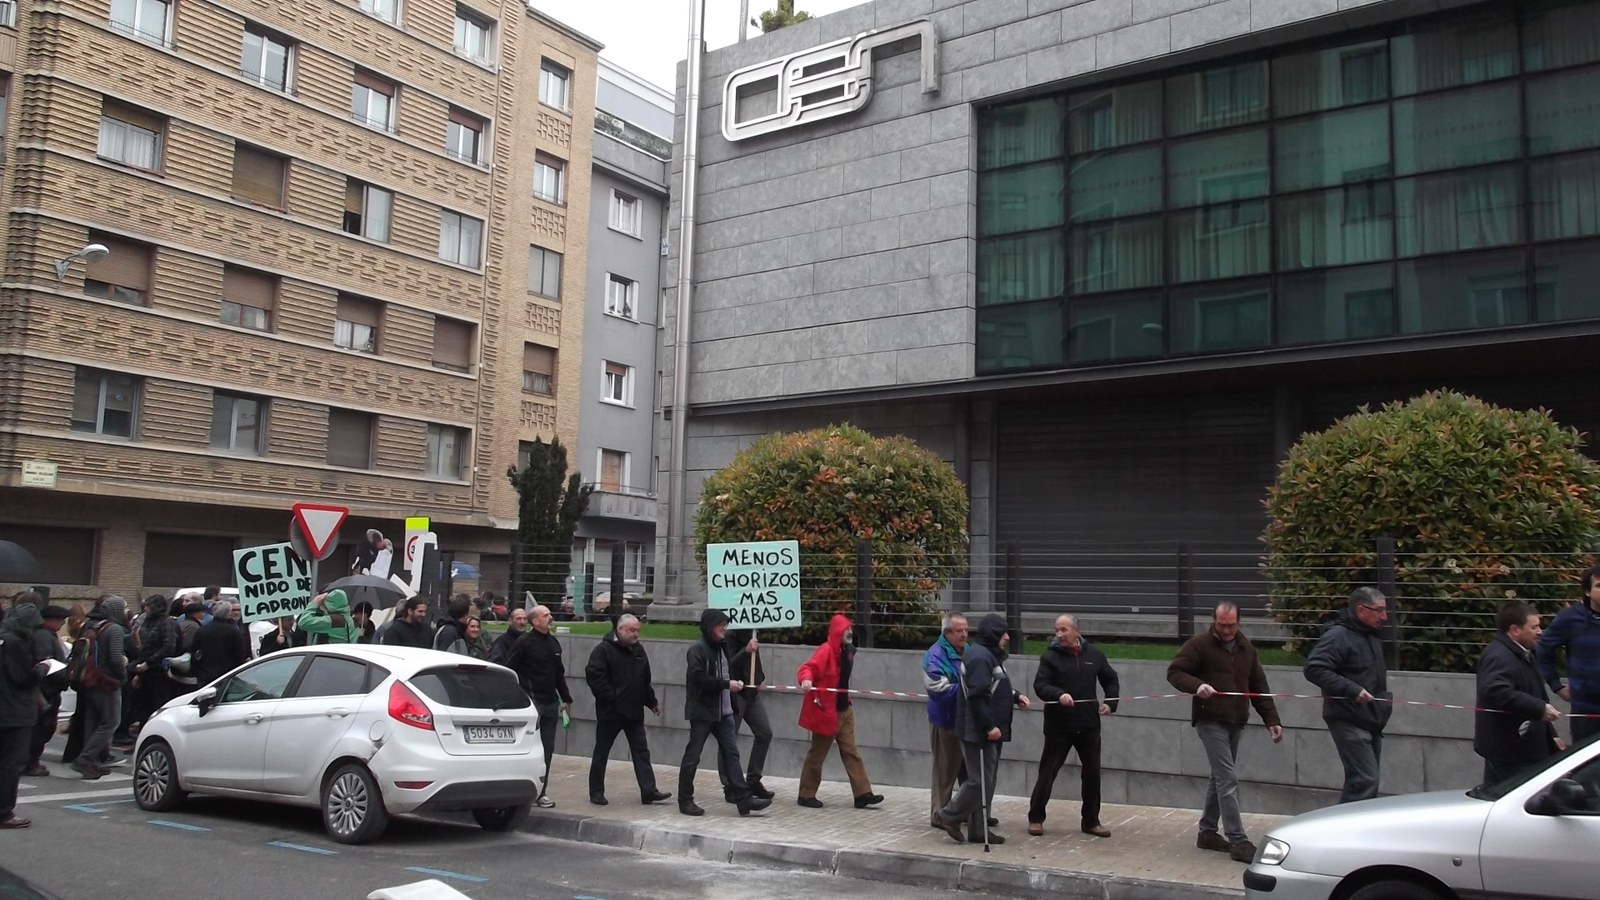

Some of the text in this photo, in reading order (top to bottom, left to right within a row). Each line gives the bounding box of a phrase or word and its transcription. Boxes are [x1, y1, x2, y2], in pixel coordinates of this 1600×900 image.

[238, 546, 307, 583] CEN
[722, 547, 793, 566] MENOS
[244, 576, 312, 598] NIDO DE
[711, 568, 799, 588] CHORIZOS
[739, 590, 778, 605] MAS
[470, 727, 494, 739] 5034
[497, 728, 514, 739] GXN
